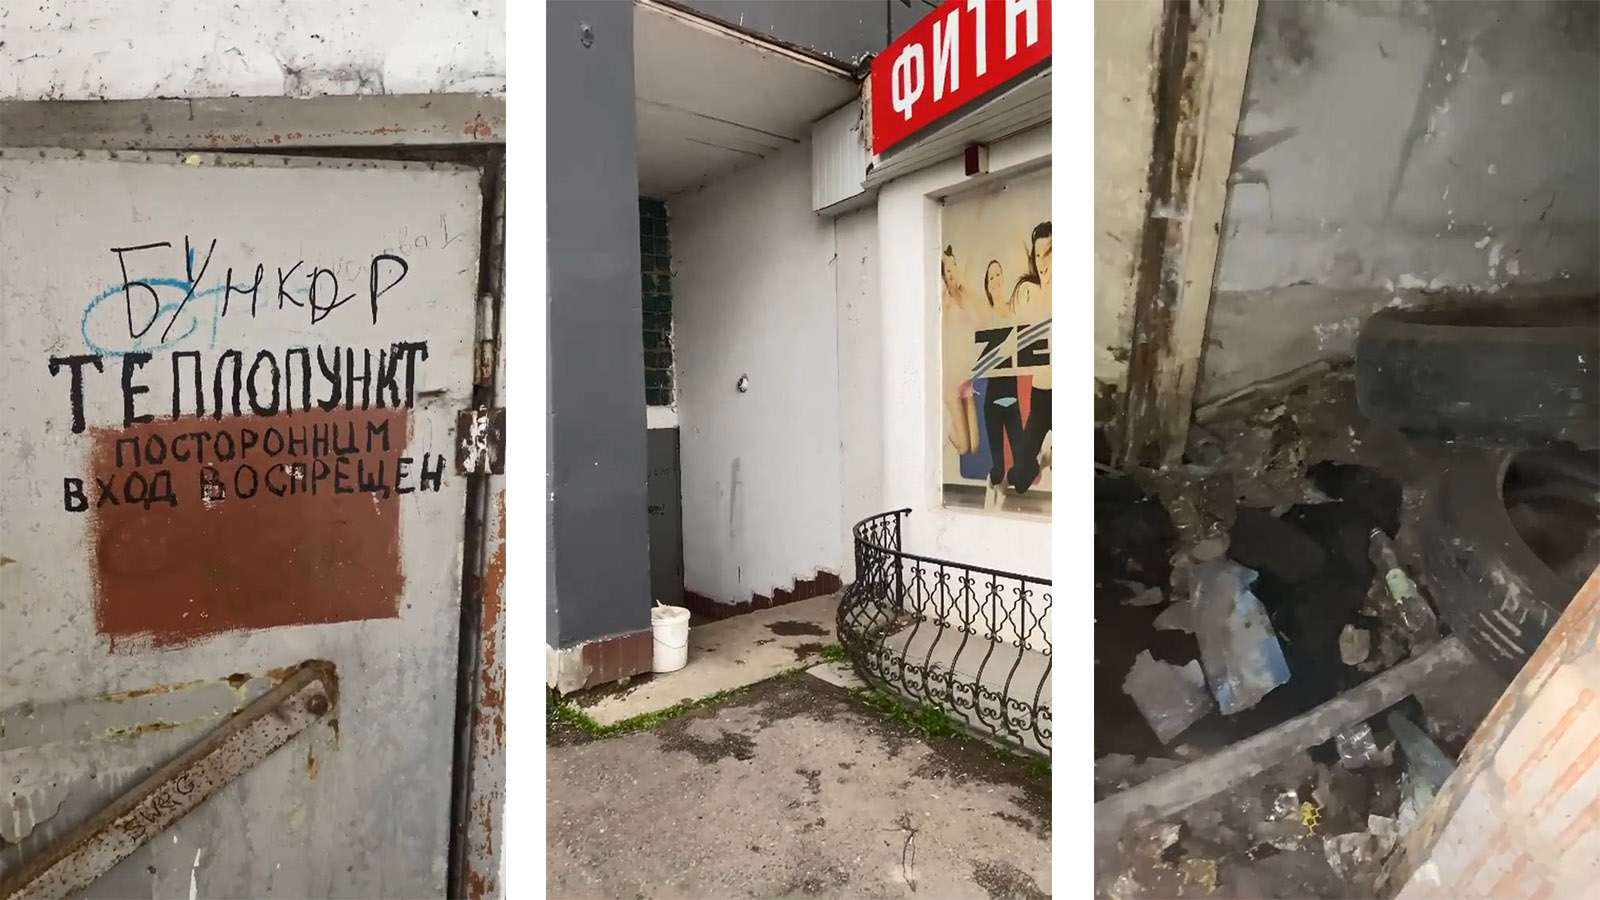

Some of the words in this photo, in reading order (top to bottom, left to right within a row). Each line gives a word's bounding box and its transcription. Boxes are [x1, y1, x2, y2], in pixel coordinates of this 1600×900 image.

[49, 341, 428, 433] ТЕПЛОПУНКТ
[64, 470, 178, 512] ВХОД
[201, 452, 446, 501] ВОСПРЕЩЕН
